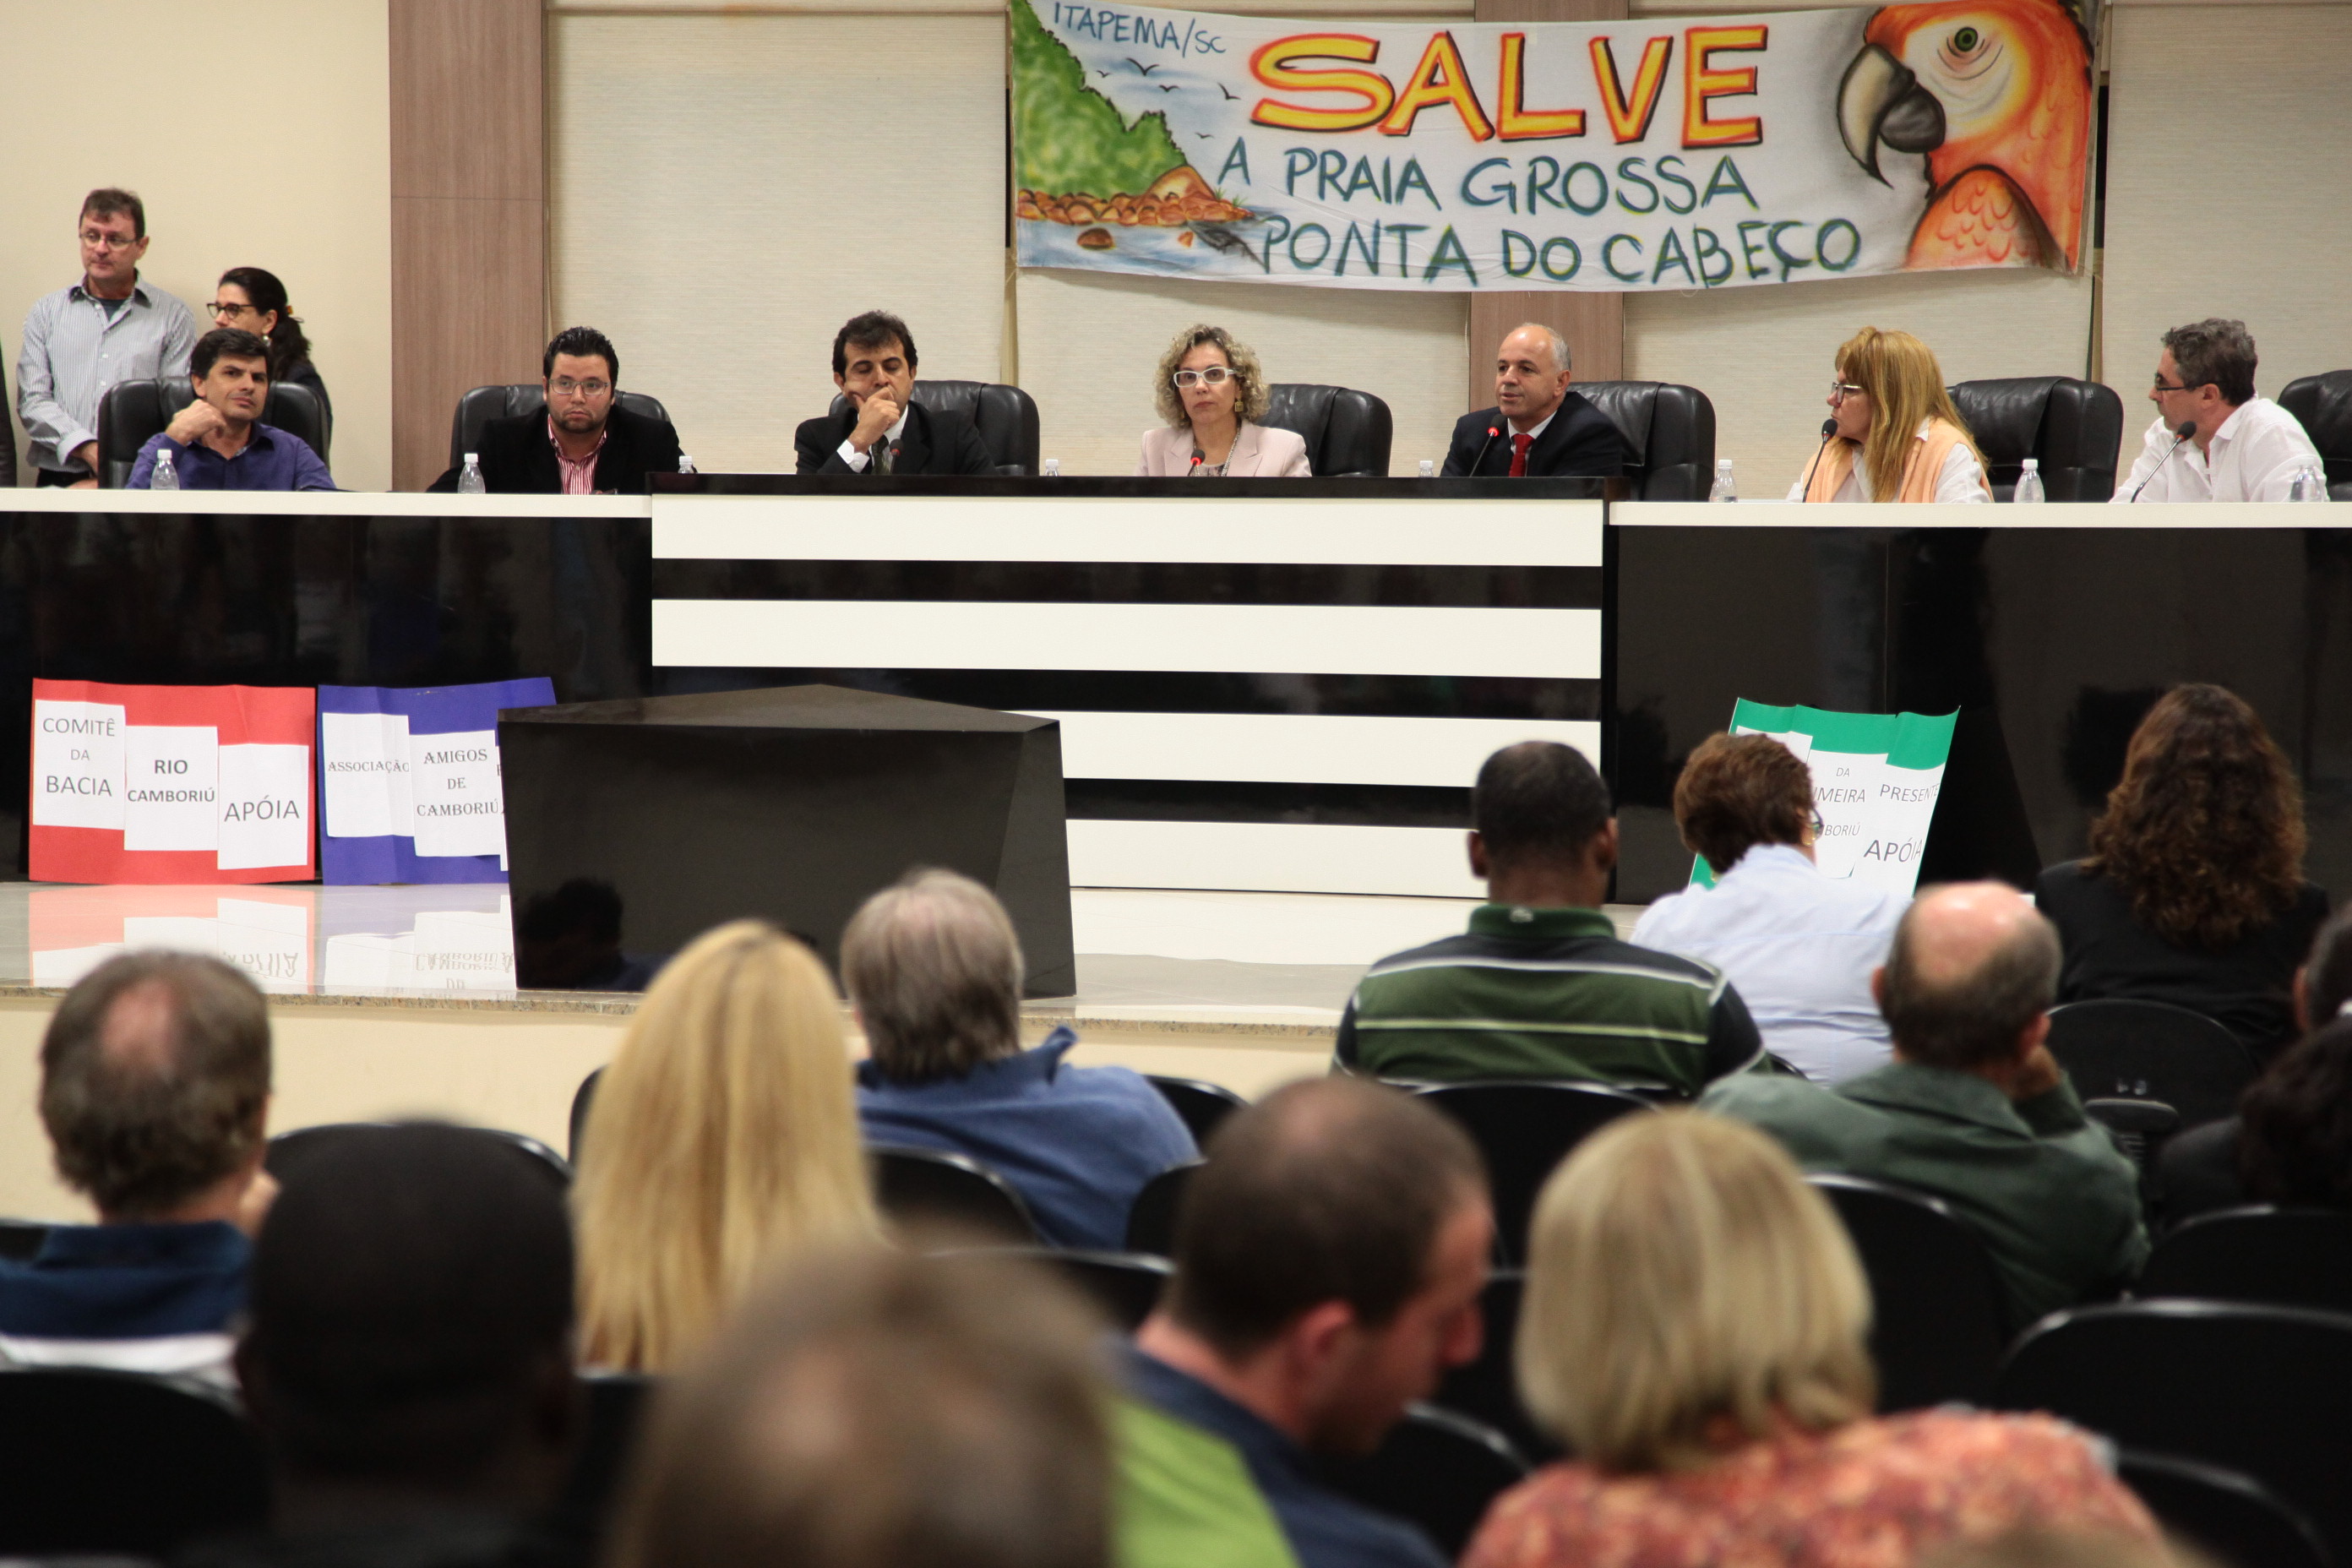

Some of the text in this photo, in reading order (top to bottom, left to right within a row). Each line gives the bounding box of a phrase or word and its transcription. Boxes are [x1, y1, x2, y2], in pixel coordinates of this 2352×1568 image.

[1054, 3, 1226, 57] ITAPEMA/SC
[1248, 24, 1768, 149] SALVE
[1217, 136, 1760, 216] A PRAIA GROSSA
[1264, 214, 1861, 288] PONTA DO CABEÇO
[42, 717, 116, 738] COMITÊ
[70, 749, 90, 761] DA
[423, 749, 487, 764] AMIGOS
[154, 760, 188, 775] RIO
[328, 760, 410, 773] ASSOCIAÇÃO
[1836, 767, 1850, 777] DA
[45, 775, 112, 798] BACIA
[447, 777, 466, 790] DE
[1880, 783, 1941, 802] PRESENTE
[128, 787, 215, 803] CAMBORIÚ
[1813, 787, 1865, 803] IMEIRA
[224, 795, 300, 822] APÓIA
[416, 798, 498, 816] CAMBORIÚ
[1825, 821, 1861, 836] BORIÚ
[1863, 837, 1924, 863] APÓIA
